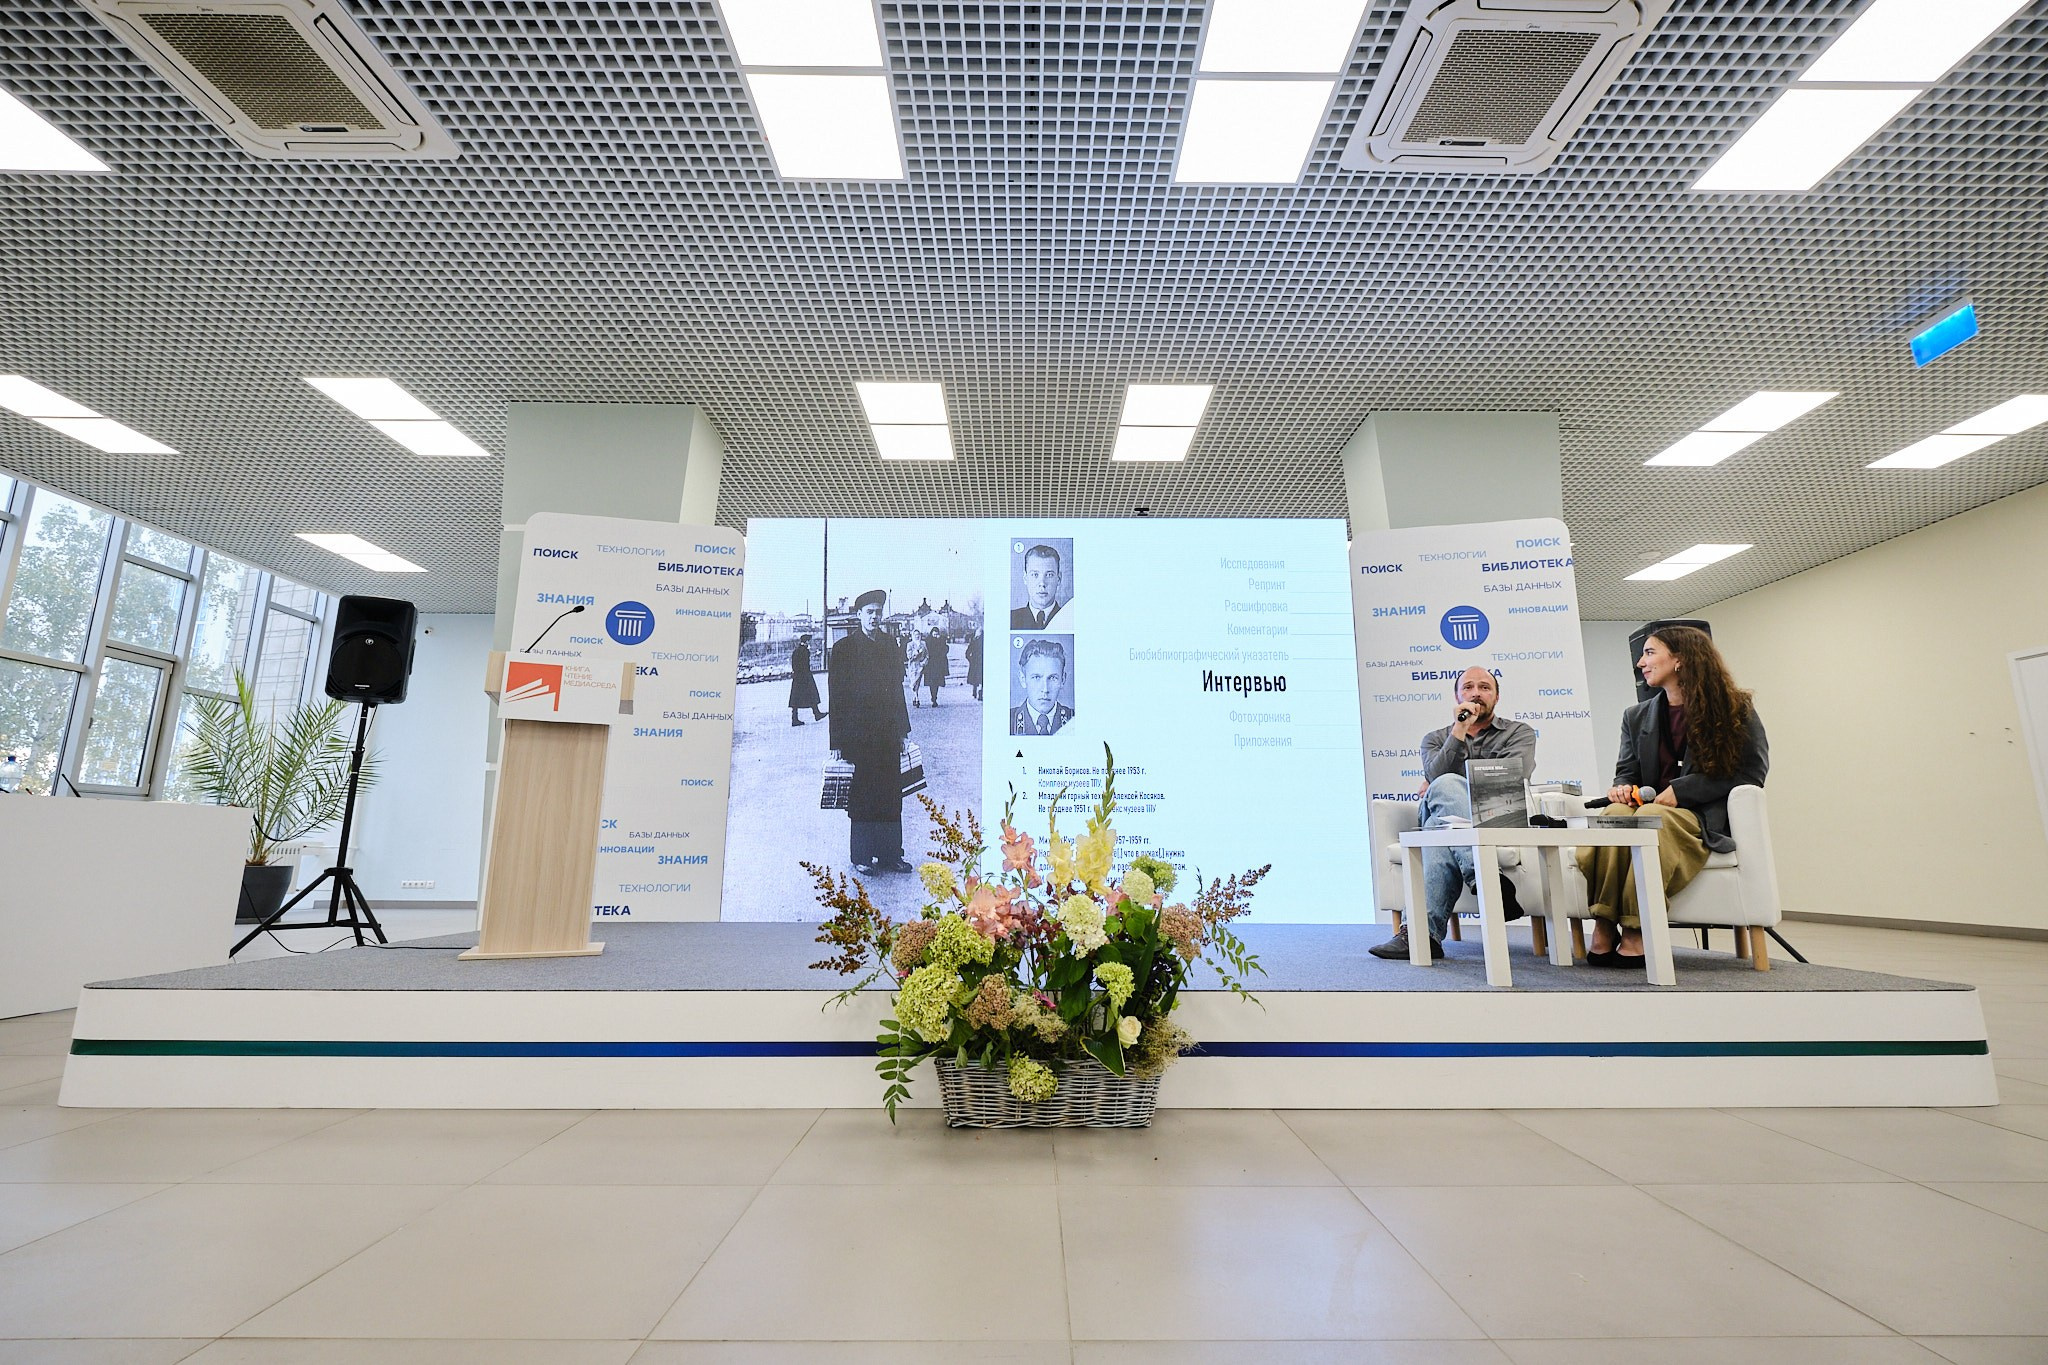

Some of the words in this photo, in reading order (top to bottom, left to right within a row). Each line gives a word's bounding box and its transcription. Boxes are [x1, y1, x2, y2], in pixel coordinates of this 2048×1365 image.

[1516, 537, 1560, 548] ПОИСК
[533, 548, 578, 559] ПОИСК
[596, 544, 665, 557] ТЕХНОЛОГИИ
[694, 544, 736, 555] ПОИСК
[1418, 550, 1487, 562] ТЕХНОЛОГИИ
[1220, 557, 1285, 570] Исследования
[1361, 564, 1403, 574] ПОИСК
[1482, 558, 1574, 572] БИБЛИОТЕКА
[658, 562, 744, 577] БИБЛИОТЕКА
[656, 584, 684, 594] БАЗЫ
[686, 586, 730, 596] ДАННЫХ
[1248, 578, 1286, 592] Репринт
[1484, 583, 1513, 593] БАЗЫ
[1515, 581, 1562, 591] ДАННЫХ
[537, 593, 595, 605] ЗНАНИЯ
[1224, 600, 1288, 614] Расшифровка
[1372, 605, 1426, 617] ЗНАНИЯ
[1508, 604, 1568, 614] ИННОВАЦИИ
[675, 608, 732, 618] ИННОВАЦИИ
[1227, 623, 1288, 638] Комментарии
[570, 636, 604, 645] ПОИСК
[1410, 645, 1442, 653] ПОИСК
[651, 652, 719, 662] ТЕХНОЛОГИИ
[1129, 647, 1240, 663] Биобиблиографический
[1242, 649, 1289, 663] указатель
[1491, 651, 1563, 662] ТЕХНОЛОГИИ
[564, 680, 616, 689] МЕДИАСРЕДА
[1202, 670, 1287, 698] Интервью
[689, 690, 721, 698] ПОИСК
[1374, 693, 1442, 703] ТЕХНОЛОГИИ
[662, 711, 690, 720] БАЗЫ
[692, 712, 733, 721] ДАННЫХ
[1229, 710, 1291, 725] Фотохроника
[1546, 711, 1590, 719] ДАННЫХ
[633, 728, 683, 738] ЗНАНИЯ
[1234, 734, 1292, 749] Приложения
[600, 846, 655, 854] ННОВАЦИИ
[657, 855, 708, 865] ЗНАНИЯ
[618, 884, 691, 893] ТЕХНОЛОГИИ
